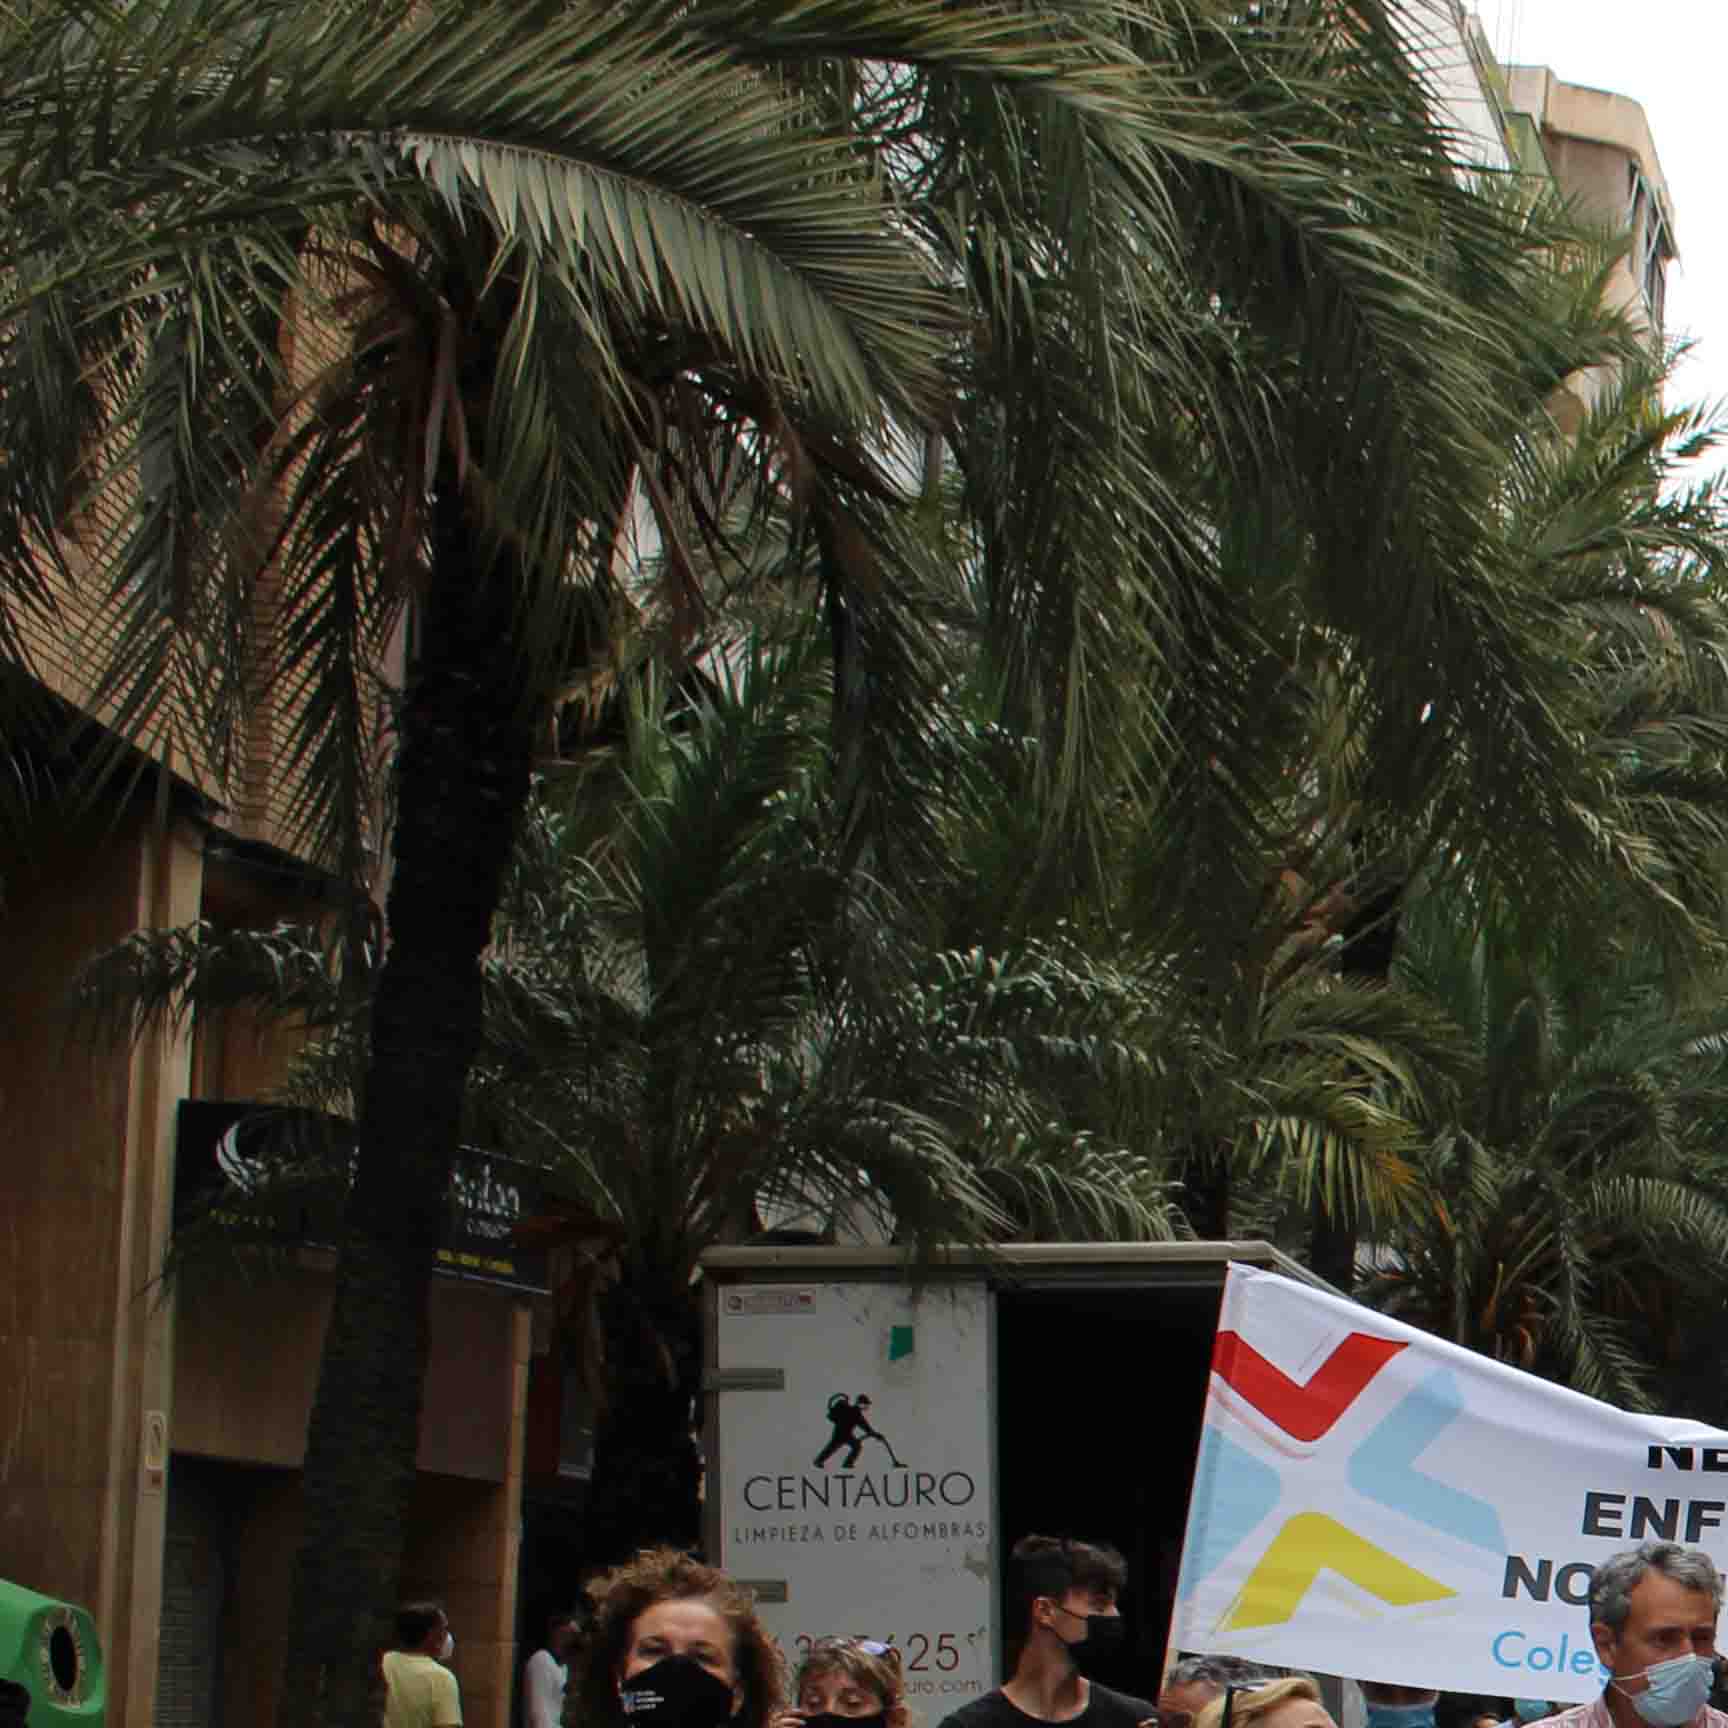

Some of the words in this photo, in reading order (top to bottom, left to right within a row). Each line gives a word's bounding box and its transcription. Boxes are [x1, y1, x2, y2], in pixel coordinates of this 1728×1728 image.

[743, 1471, 975, 1512] CENTAURO
[735, 1525, 825, 1544] LIMPIEZA
[833, 1524, 858, 1542] DE
[867, 1519, 987, 1542] ALFOMBRAS
[1502, 1554, 1596, 1606] NO
